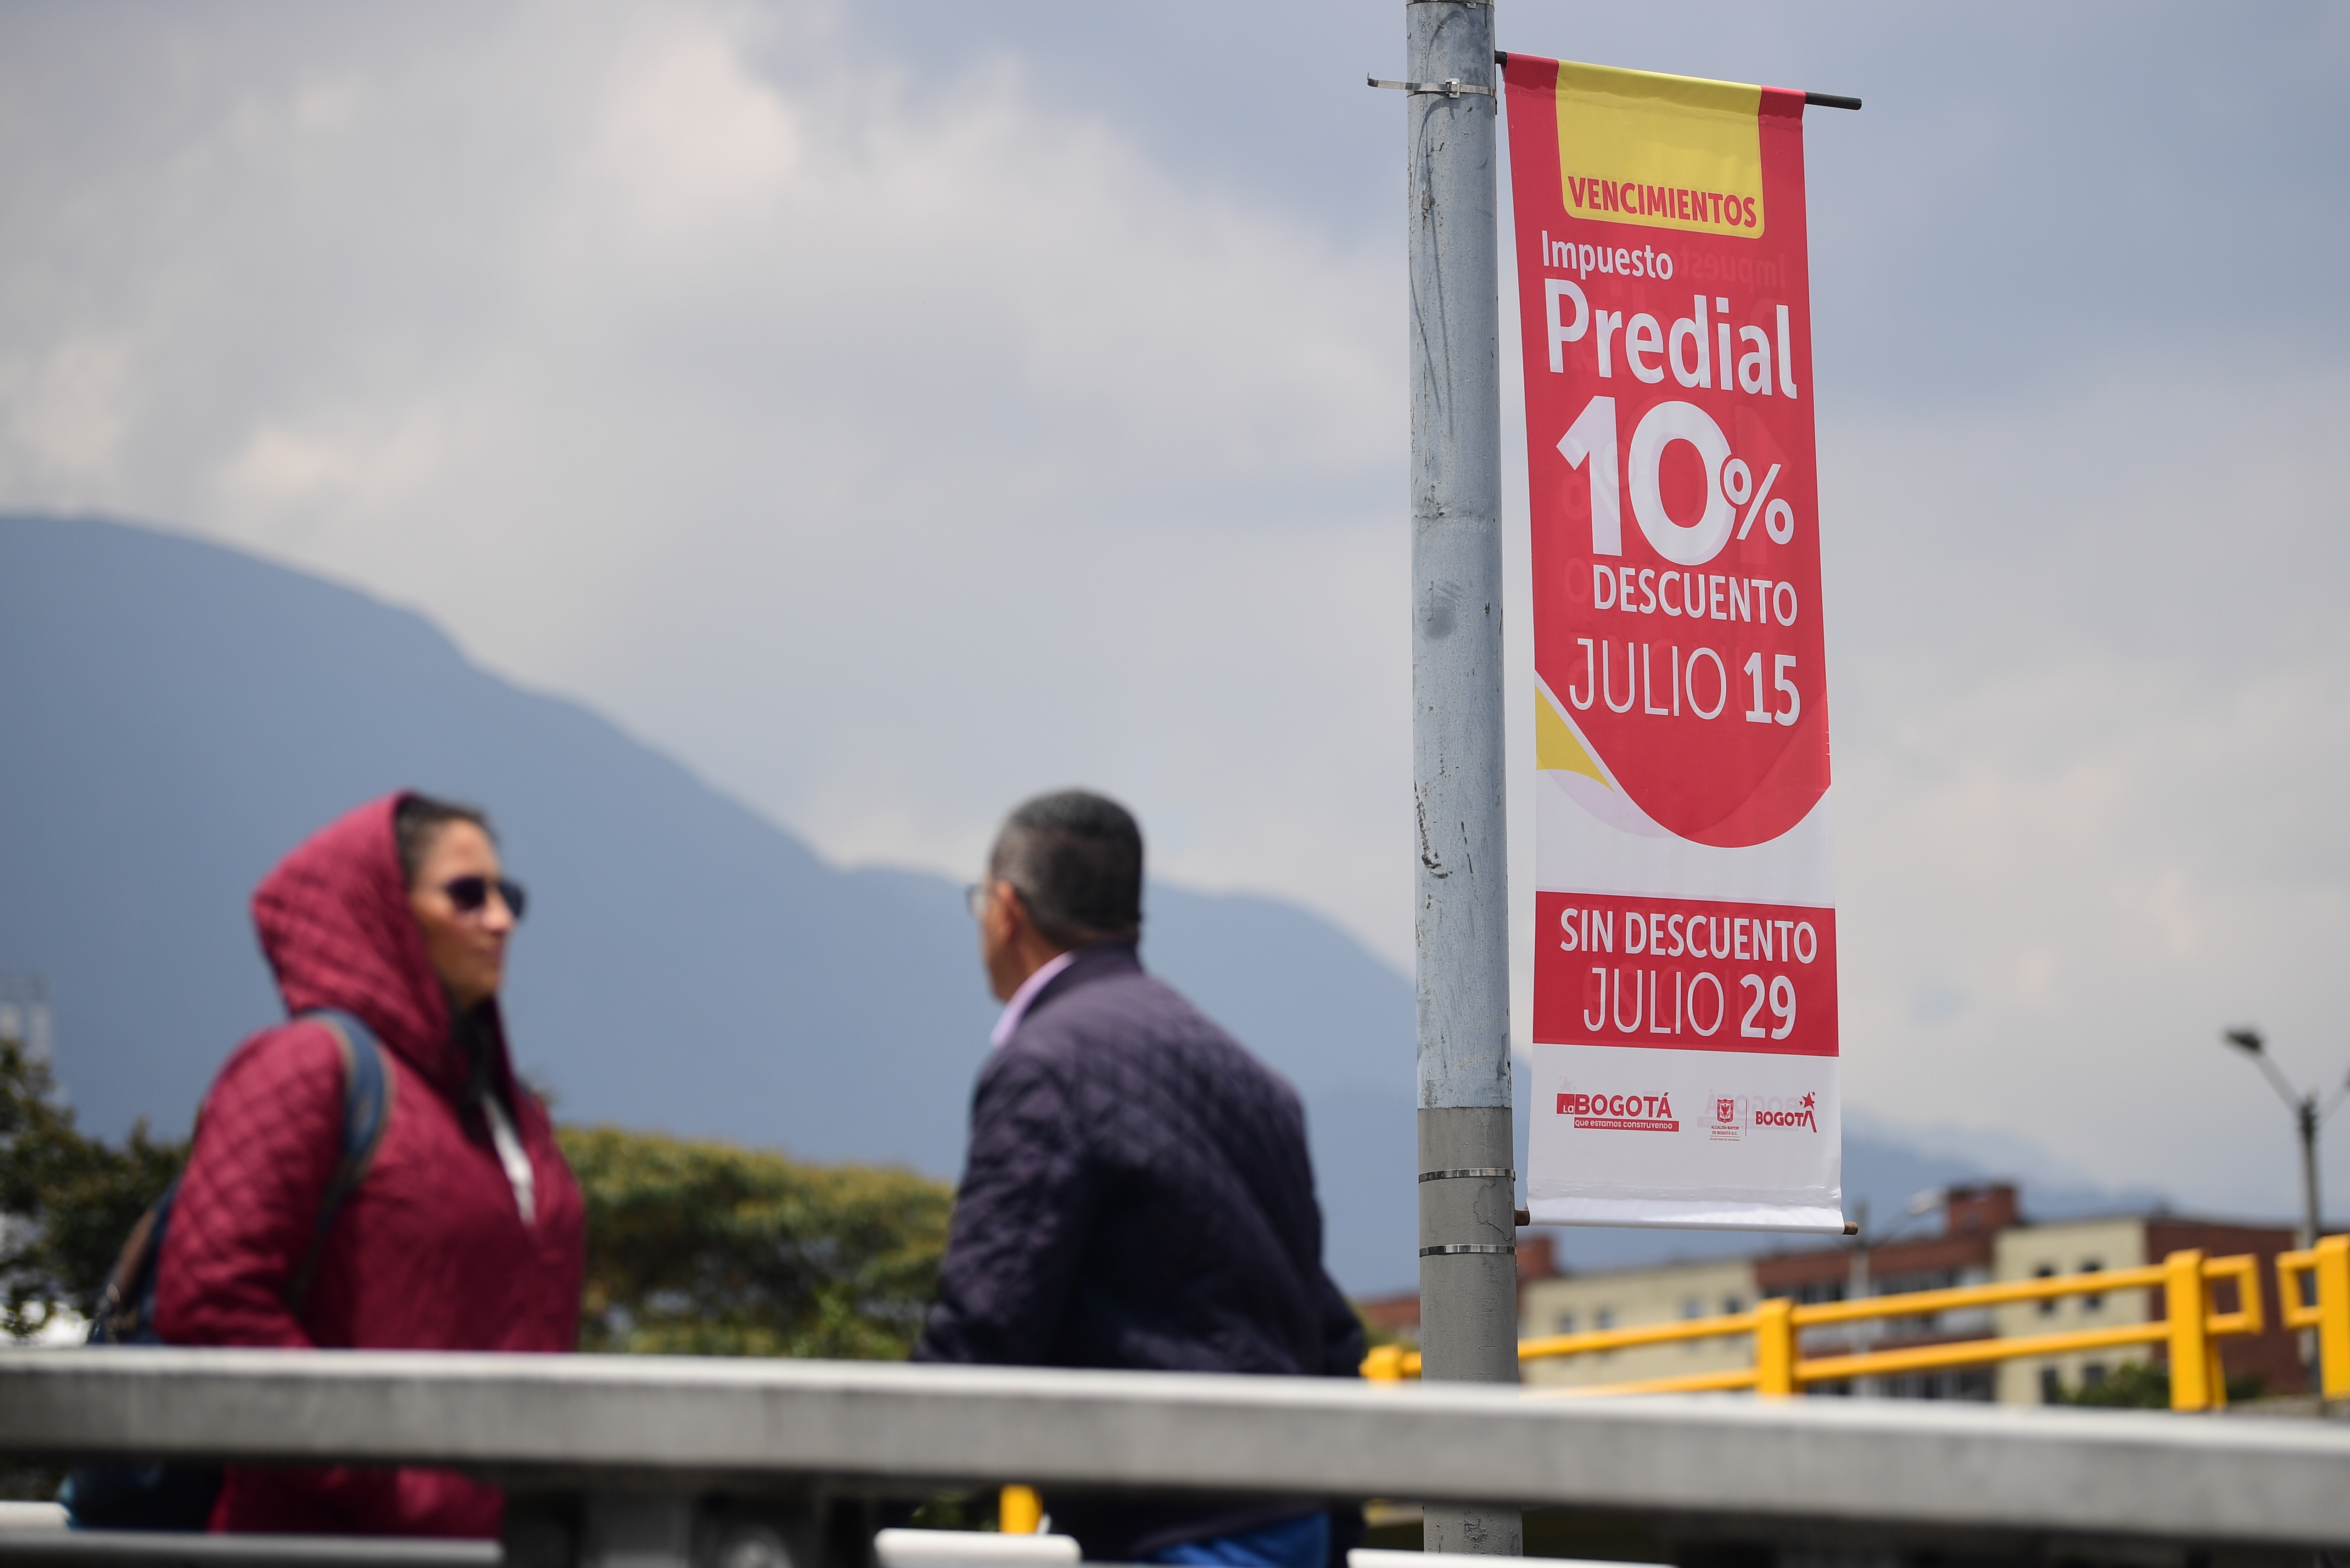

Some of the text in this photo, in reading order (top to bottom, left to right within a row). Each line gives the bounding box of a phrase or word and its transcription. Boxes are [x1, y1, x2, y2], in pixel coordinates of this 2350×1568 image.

[1567, 176, 1757, 229] VENCIMIENTOS
[1542, 230, 1673, 280] Impuesto
[1544, 278, 1797, 399] Predial
[1555, 395, 1795, 566] 10%
[1593, 564, 1798, 626] DESCUENTO
[1569, 638, 1801, 726] JULIO 15
[1560, 908, 1818, 964] SIN DESCUENTO
[1583, 967, 1796, 1040] JULIO 29
[1574, 1092, 1673, 1119] BOGOTÁ
